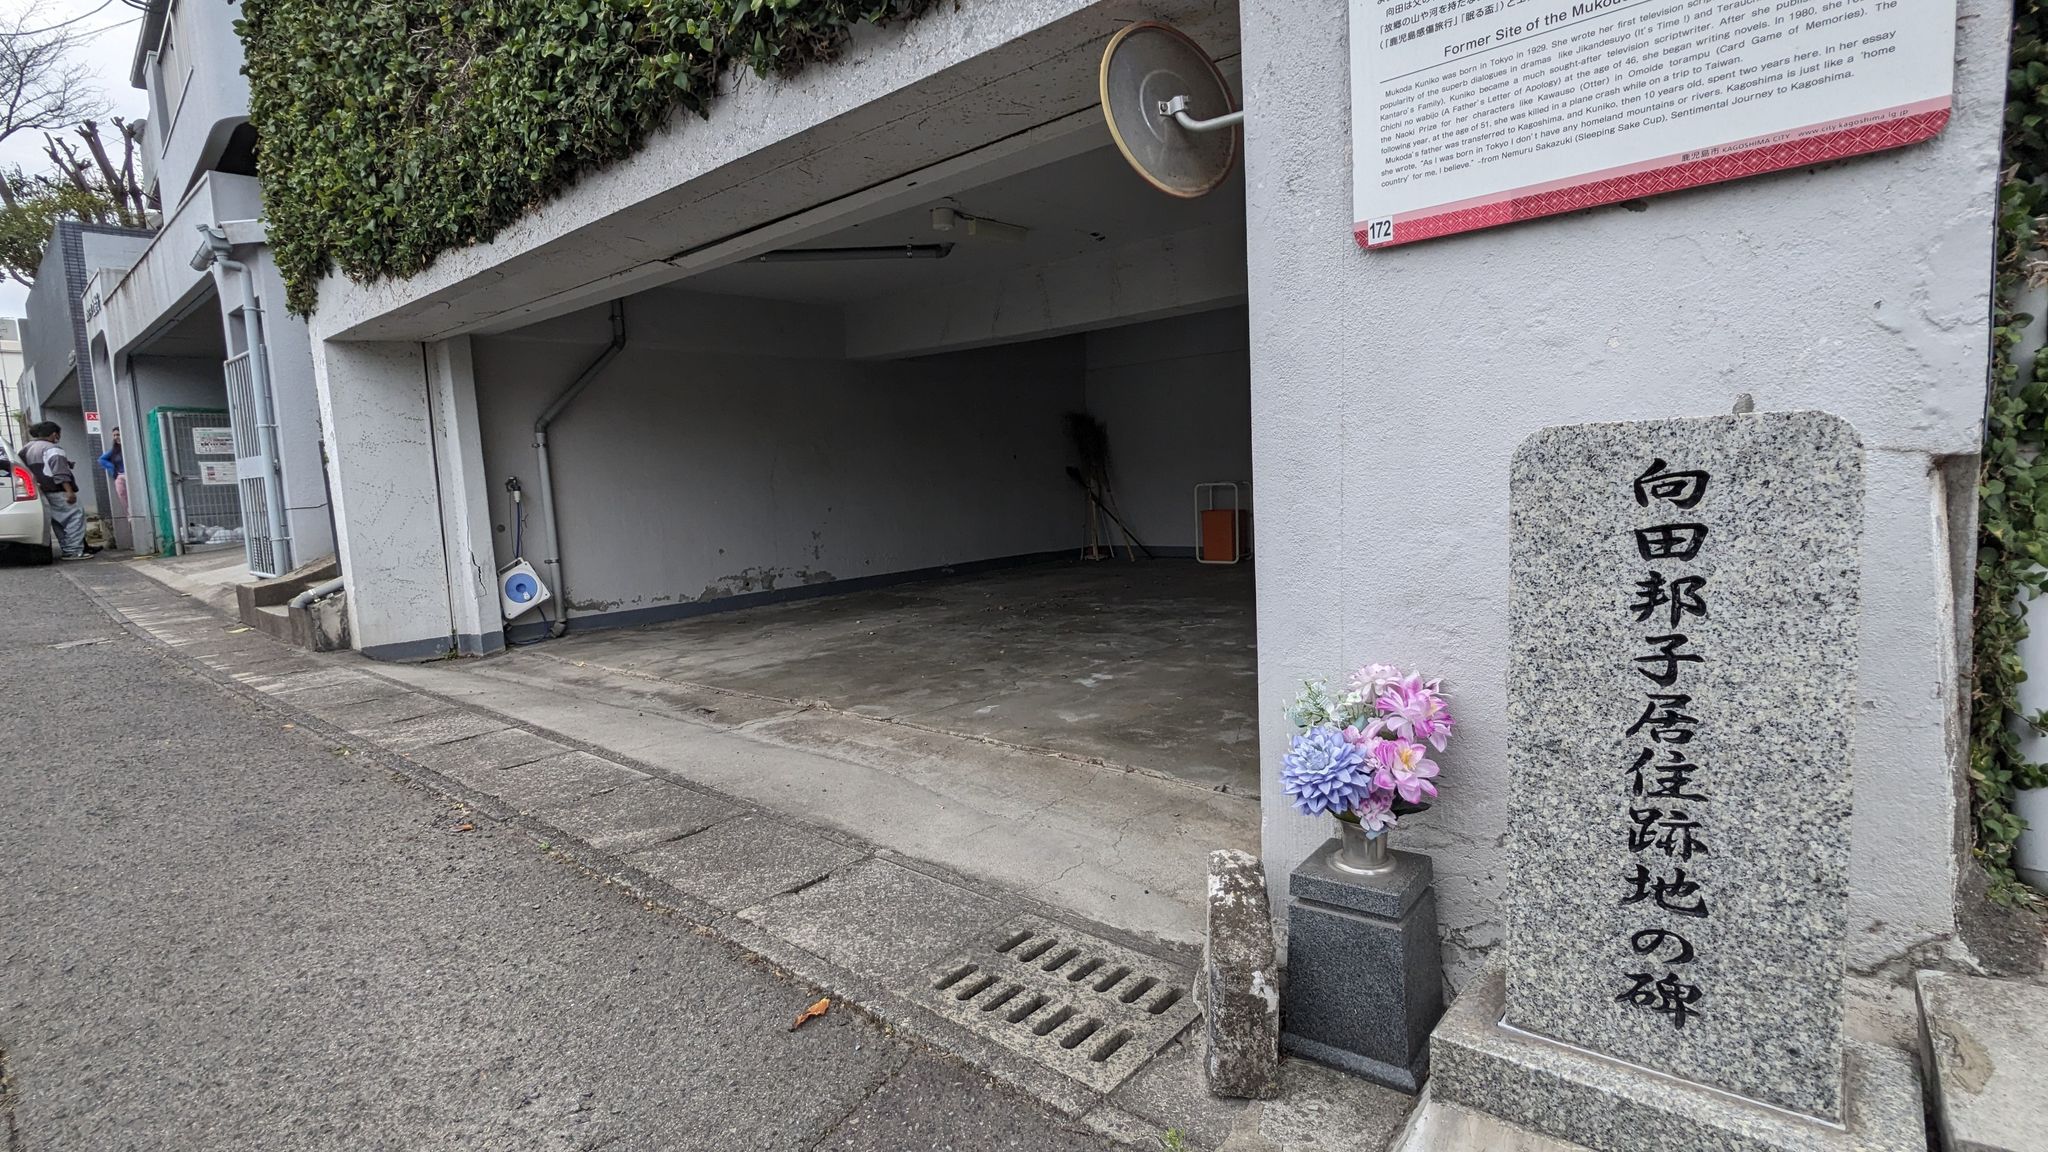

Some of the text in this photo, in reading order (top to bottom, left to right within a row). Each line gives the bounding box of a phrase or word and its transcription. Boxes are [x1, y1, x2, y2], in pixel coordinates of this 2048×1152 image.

[1639, 4, 1684, 22] television
[1599, 24, 1614, 34] her
[1617, 17, 1636, 29] first
[1444, 35, 1491, 57] Former
[1496, 26, 1522, 41] Site
[1526, 16, 1540, 32] of
[1544, 11, 1567, 26] the
[1570, 30, 1596, 43] wrote
[1862, 30, 1896, 45] essay
[1527, 43, 1548, 55] 1929.
[1551, 39, 1568, 48] She
[1825, 46, 1835, 54] In
[1839, 40, 1858, 51] her
[1380, 96, 1415, 112] popularity
[1417, 91, 1424, 100] of
[1427, 89, 1439, 97] the
[1441, 80, 1468, 93] superb
[1470, 69, 1507, 84] dialogues
[1520, 56, 1552, 70] dramas
[1558, 50, 1573, 59] like
[1576, 33, 1631, 54] Jikandesuyo
[1657, 19, 1680, 30] Time
[1694, 7, 1712, 20] and
[1417, 98, 1446, 111] Family),
[1449, 90, 1475, 102] Kuniko
[1479, 80, 1510, 94] became
[1522, 70, 1545, 82] much
[1549, 54, 1602, 74] sought-after
[1607, 41, 1649, 58] television
[1654, 23, 1714, 45] scriptwriter.
[1719, 13, 1746, 26] After
[1751, 6, 1770, 18] she
[1490, 55, 1514, 67] Tokyo
[1793, 50, 1821, 62] here.
[1380, 121, 1402, 133] Chichi
[1416, 112, 1439, 123] wabijo
[1441, 108, 1450, 117] (A
[1487, 92, 1511, 103] Letter
[1514, 87, 1522, 96] of
[1525, 77, 1562, 93] Apology)
[1564, 74, 1573, 82] at
[1576, 70, 1591, 79] the
[1594, 65, 1610, 74] age
[1613, 60, 1622, 69] of
[1625, 56, 1639, 65] 46,
[1642, 51, 1659, 61] she
[1662, 42, 1692, 56] began
[1696, 31, 1730, 46] writing
[1734, 21, 1770, 36] novels.
[1775, 16, 1784, 25] In
[1789, 6, 1817, 20] 1980,
[1822, 1, 1842, 12] she
[1395, 128, 1415, 140] Naoki
[1419, 124, 1437, 134] Prize
[1441, 120, 1452, 128] for
[1456, 115, 1468, 124] her
[1472, 103, 1515, 120] characters
[1519, 98, 1533, 107] like
[1538, 87, 1575, 102] Kawauso
[1580, 76, 1610, 92] (Otter)
[1614, 74, 1623, 82] in
[1628, 63, 1664, 78] Omoide
[1669, 51, 1710, 67] torampu
[1716, 40, 1745, 55] (Card
[1751, 32, 1782, 45] Game
[1788, 25, 1799, 35] of
[1806, 8, 1868, 31] Memories).
[1875, 1, 1897, 12] The
[1459, 66, 1477, 76] born
[1739, 66, 1758, 76] two
[1760, 57, 1790, 72] years
[1415, 77, 1440, 89] Kuniko
[1442, 72, 1457, 81] was
[1707, 70, 1736, 84] spent
[1687, 78, 1704, 89] old,
[1385, 85, 1412, 98] Mukoda
[1644, 90, 1655, 100] 10
[1658, 84, 1684, 98] years
[1381, 142, 1411, 154] following
[1413, 137, 1430, 147] year,
[1442, 131, 1454, 139] the
[1455, 127, 1469, 136] age
[1471, 123, 1478, 132] of
[1480, 120, 1492, 129] 51,
[1494, 117, 1508, 126] she
[1510, 112, 1526, 121] was
[1528, 104, 1549, 117] killed
[1569, 95, 1593, 107] plane
[1595, 87, 1620, 100] crash
[1623, 81, 1646, 92] while
[1649, 77, 1661, 86] on
[1672, 70, 1690, 80] trip
[1692, 66, 1702, 74] to
[1705, 56, 1743, 70] Taiwan.
[1621, 95, 1641, 106] then
[1567, 108, 1583, 119] and
[1586, 102, 1618, 114] Kuniko,
[1395, 164, 1417, 173] wrote,
[1439, 154, 1454, 162] was
[1456, 149, 1474, 159] born
[1485, 141, 1509, 151] Tokyo
[1540, 128, 1560, 138] have
[1562, 123, 1578, 133] any
[1581, 111, 1623, 128] homeland
[1626, 100, 1675, 117] mountains
[1677, 96, 1688, 105] or
[1692, 89, 1723, 101] rivers.
[1727, 73, 1783, 93] Kagoshima
[1787, 69, 1796, 78] is
[1799, 63, 1820, 76] just
[1824, 59, 1843, 69] like
[1412, 172, 1423, 180] for
[1501, 147, 1533, 159] Nemuru
[1536, 136, 1572, 151] Sakazuki
[1575, 127, 1616, 143] (Sleeping
[1618, 121, 1640, 132] Sake
[1642, 114, 1668, 126] Cup),
[1671, 98, 1729, 120] Sentimental
[1731, 89, 1774, 105] Journey
[1776, 86, 1788, 94] to
[1790, 71, 1854, 91] Kagoshima.
[1518, 115, 1564, 131] Kagoshima,
[1461, 128, 1505, 146] transferred
[1421, 145, 1443, 156] father
[1444, 141, 1459, 150] was
[1681, 146, 1718, 161] 鹿児島市
[1722, 138, 1770, 152] KAGOSHIMA
[1773, 133, 1790, 142] CITY
[1370, 220, 1391, 239] 172
[1616, 457, 1711, 1029] 向田邦子居住跡地の碑
